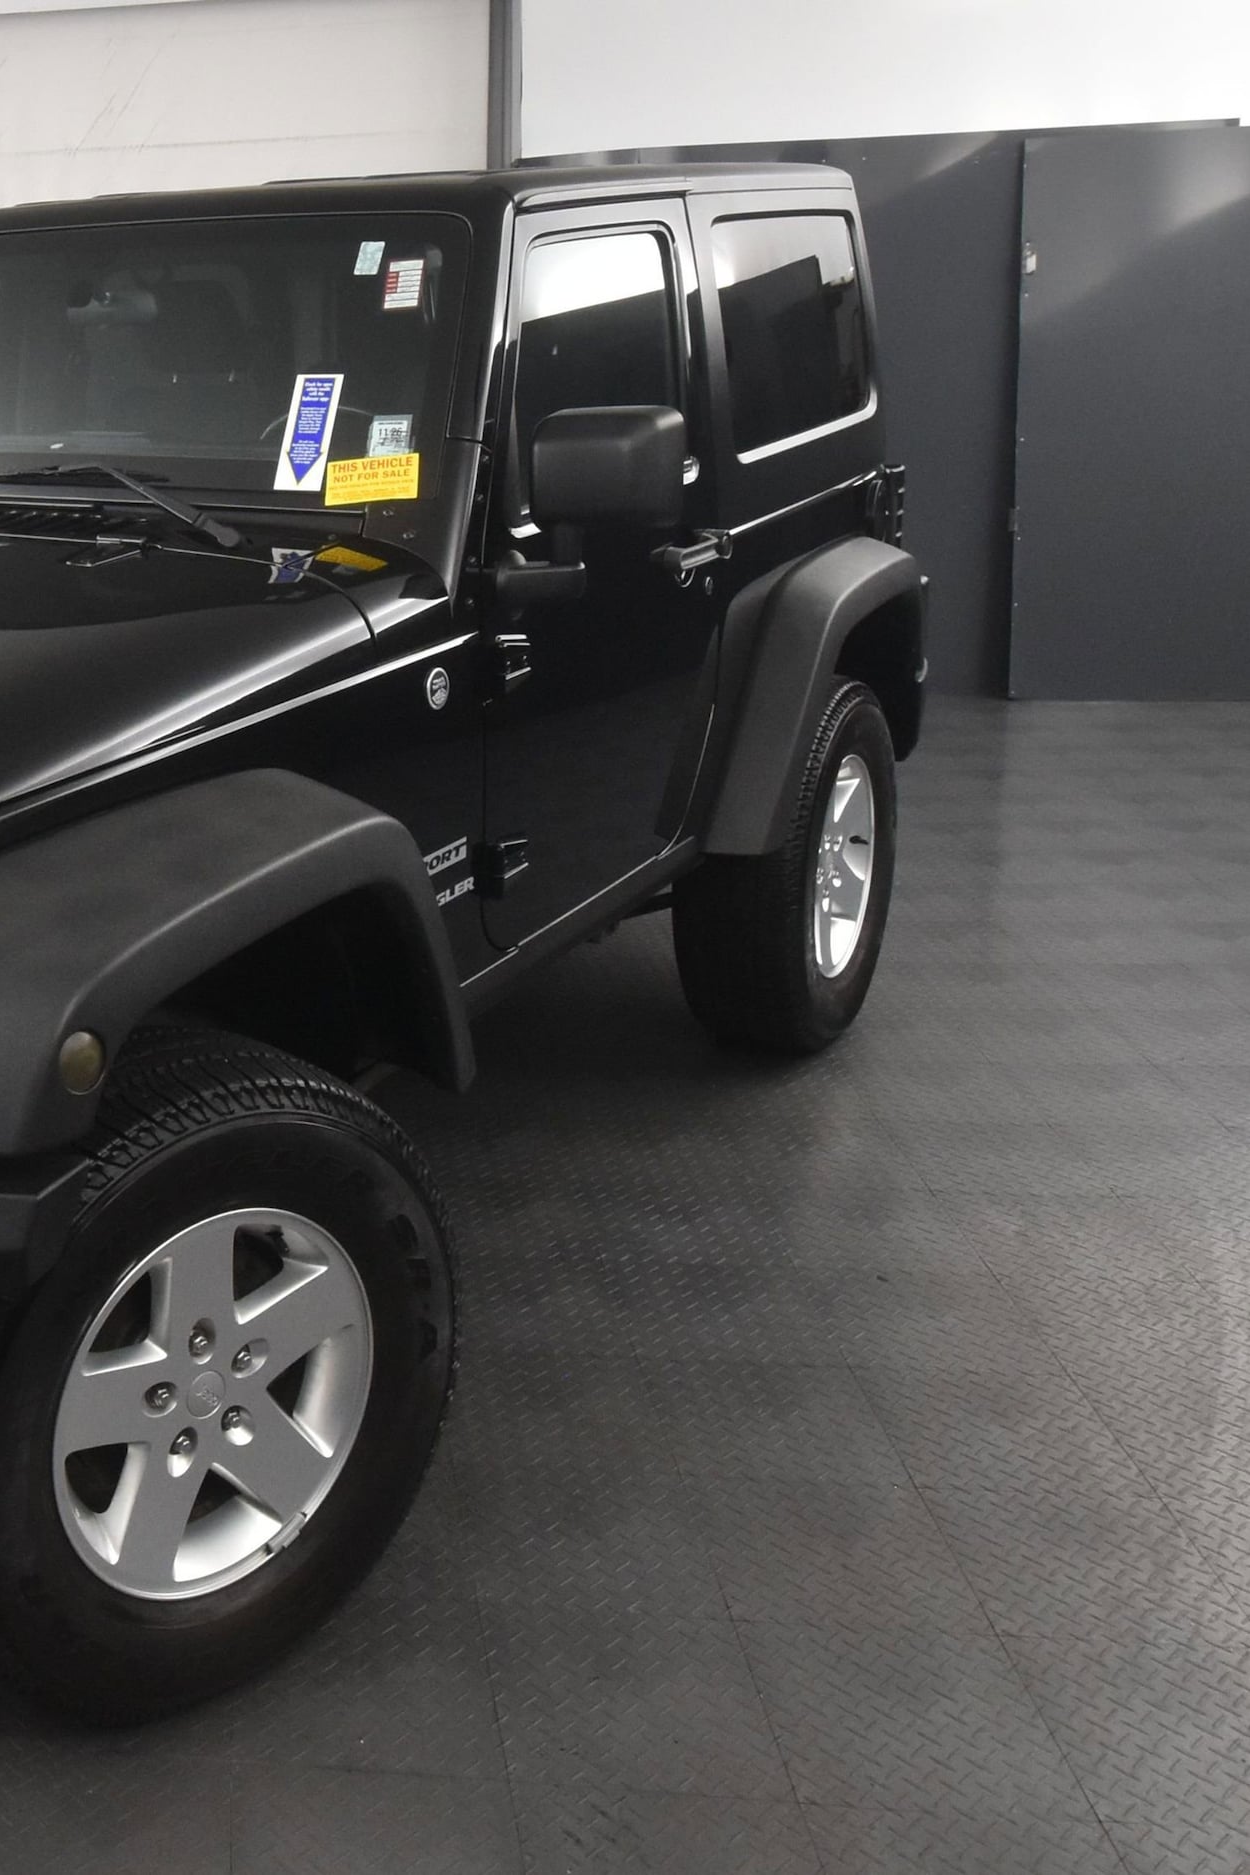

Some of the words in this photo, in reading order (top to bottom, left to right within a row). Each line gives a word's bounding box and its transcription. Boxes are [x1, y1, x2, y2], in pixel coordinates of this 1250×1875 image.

[331, 462, 358, 475] THIS
[361, 456, 414, 472] VEHICLE
[333, 474, 354, 484] NOT
[357, 471, 379, 481] FOR
[382, 468, 411, 479] SALE
[427, 842, 467, 871] ORT
